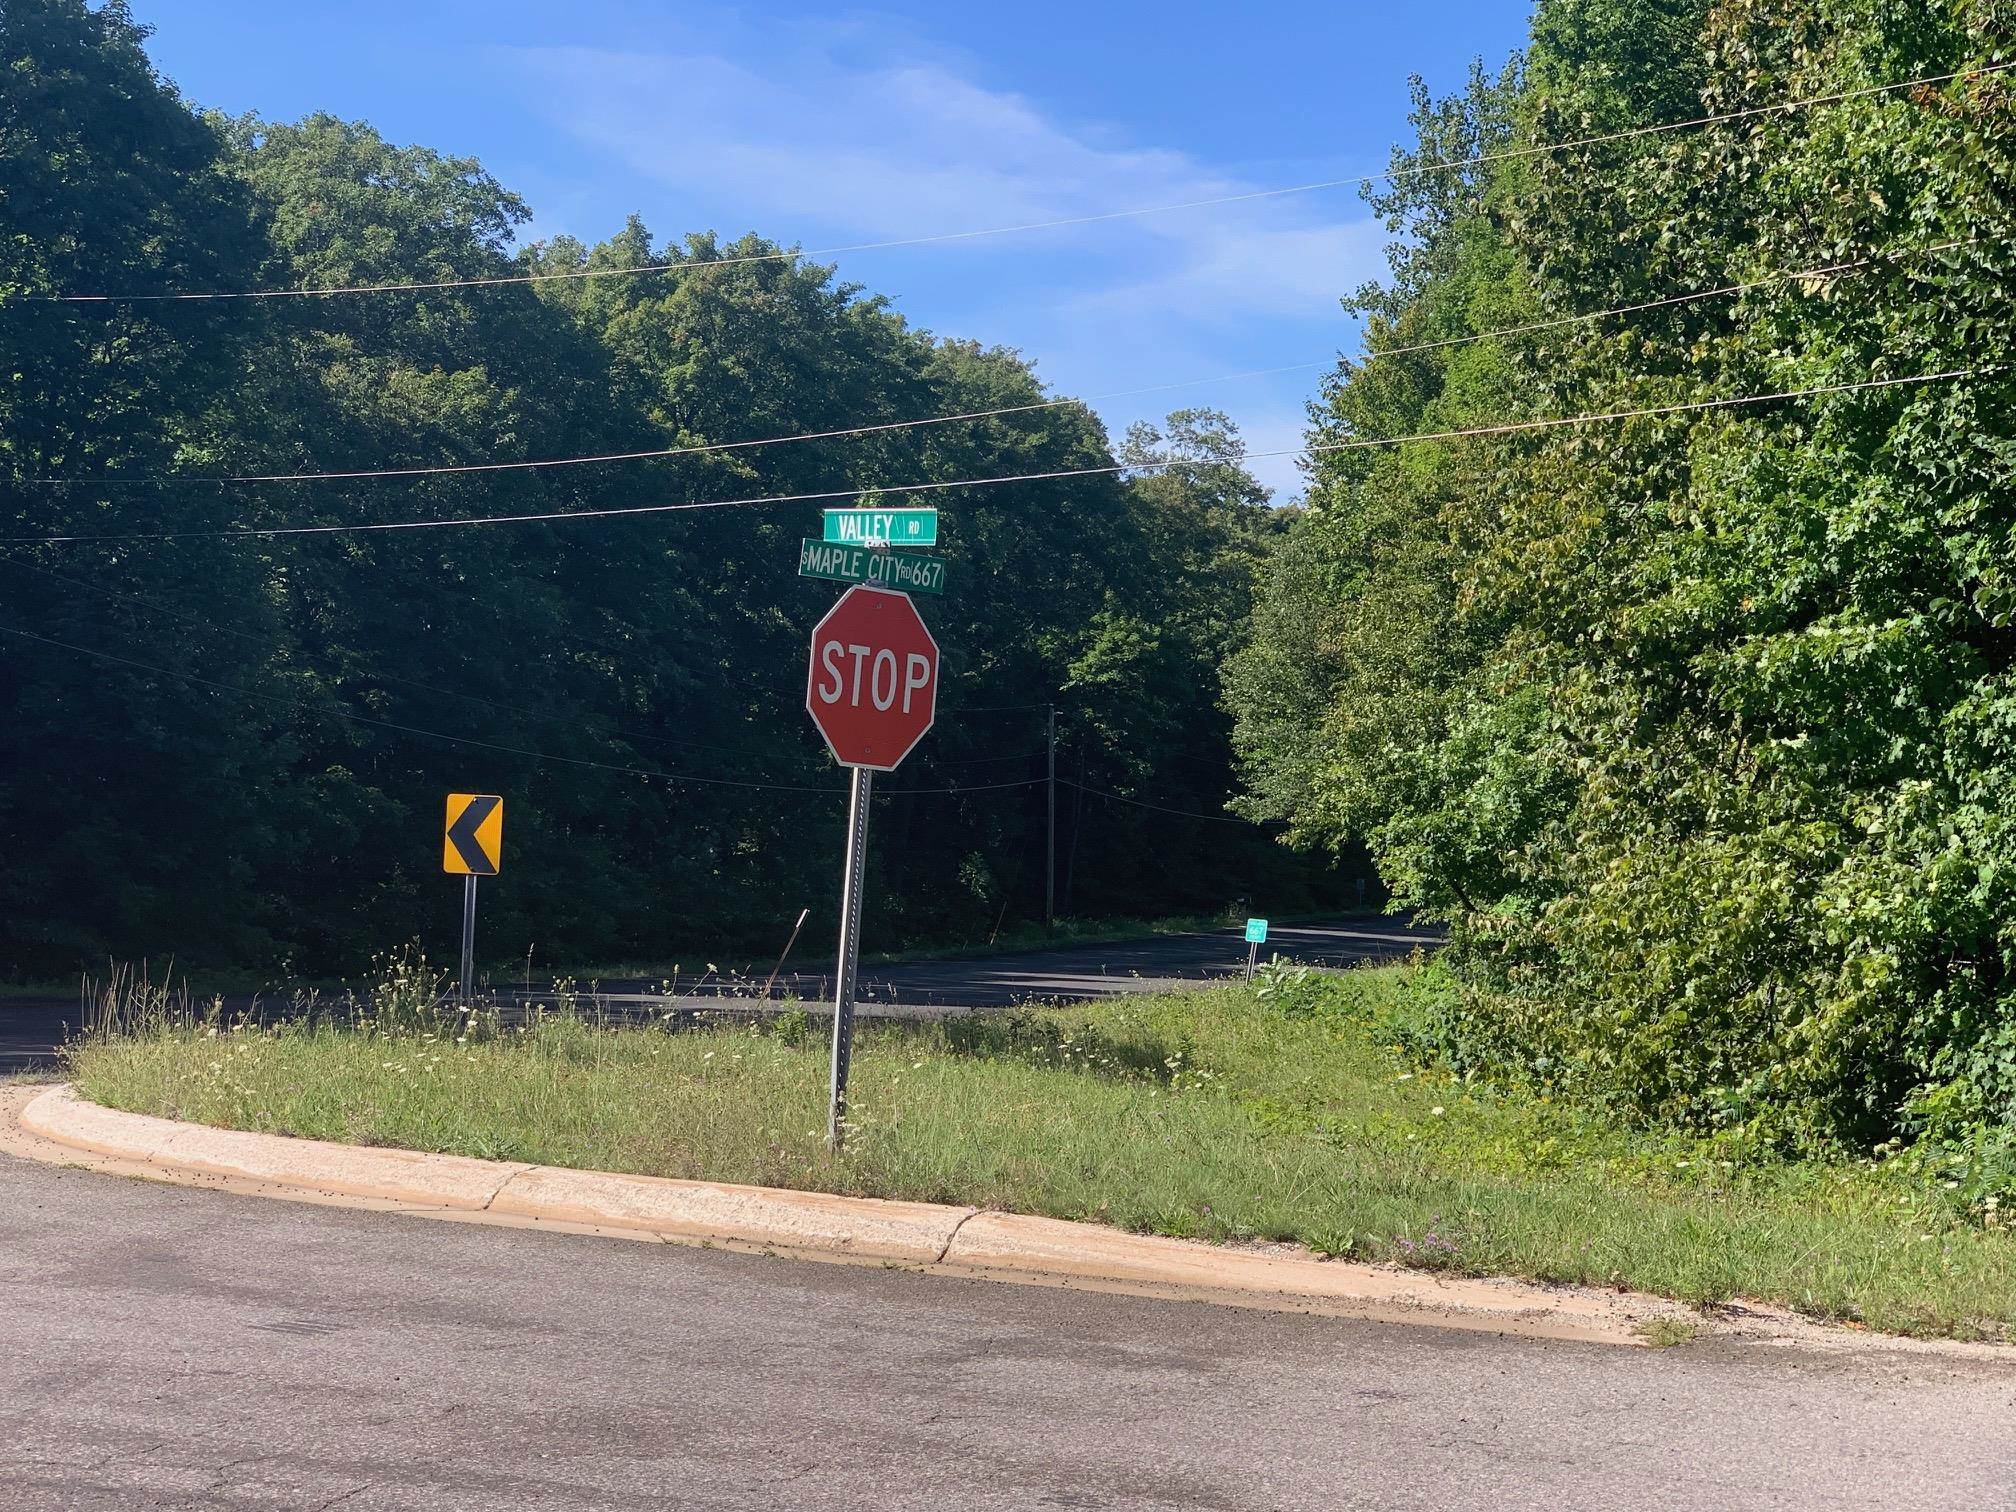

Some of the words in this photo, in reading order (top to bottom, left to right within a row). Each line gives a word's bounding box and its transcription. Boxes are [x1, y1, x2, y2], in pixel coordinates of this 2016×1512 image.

[839, 515, 894, 541] VALLEY
[908, 521, 920, 535] RD
[802, 551, 809, 565] S
[808, 546, 863, 578] MAPLE
[868, 555, 903, 583] CITY
[901, 562, 911, 580] RD
[912, 562, 942, 588] 667
[818, 640, 931, 714] STOP
